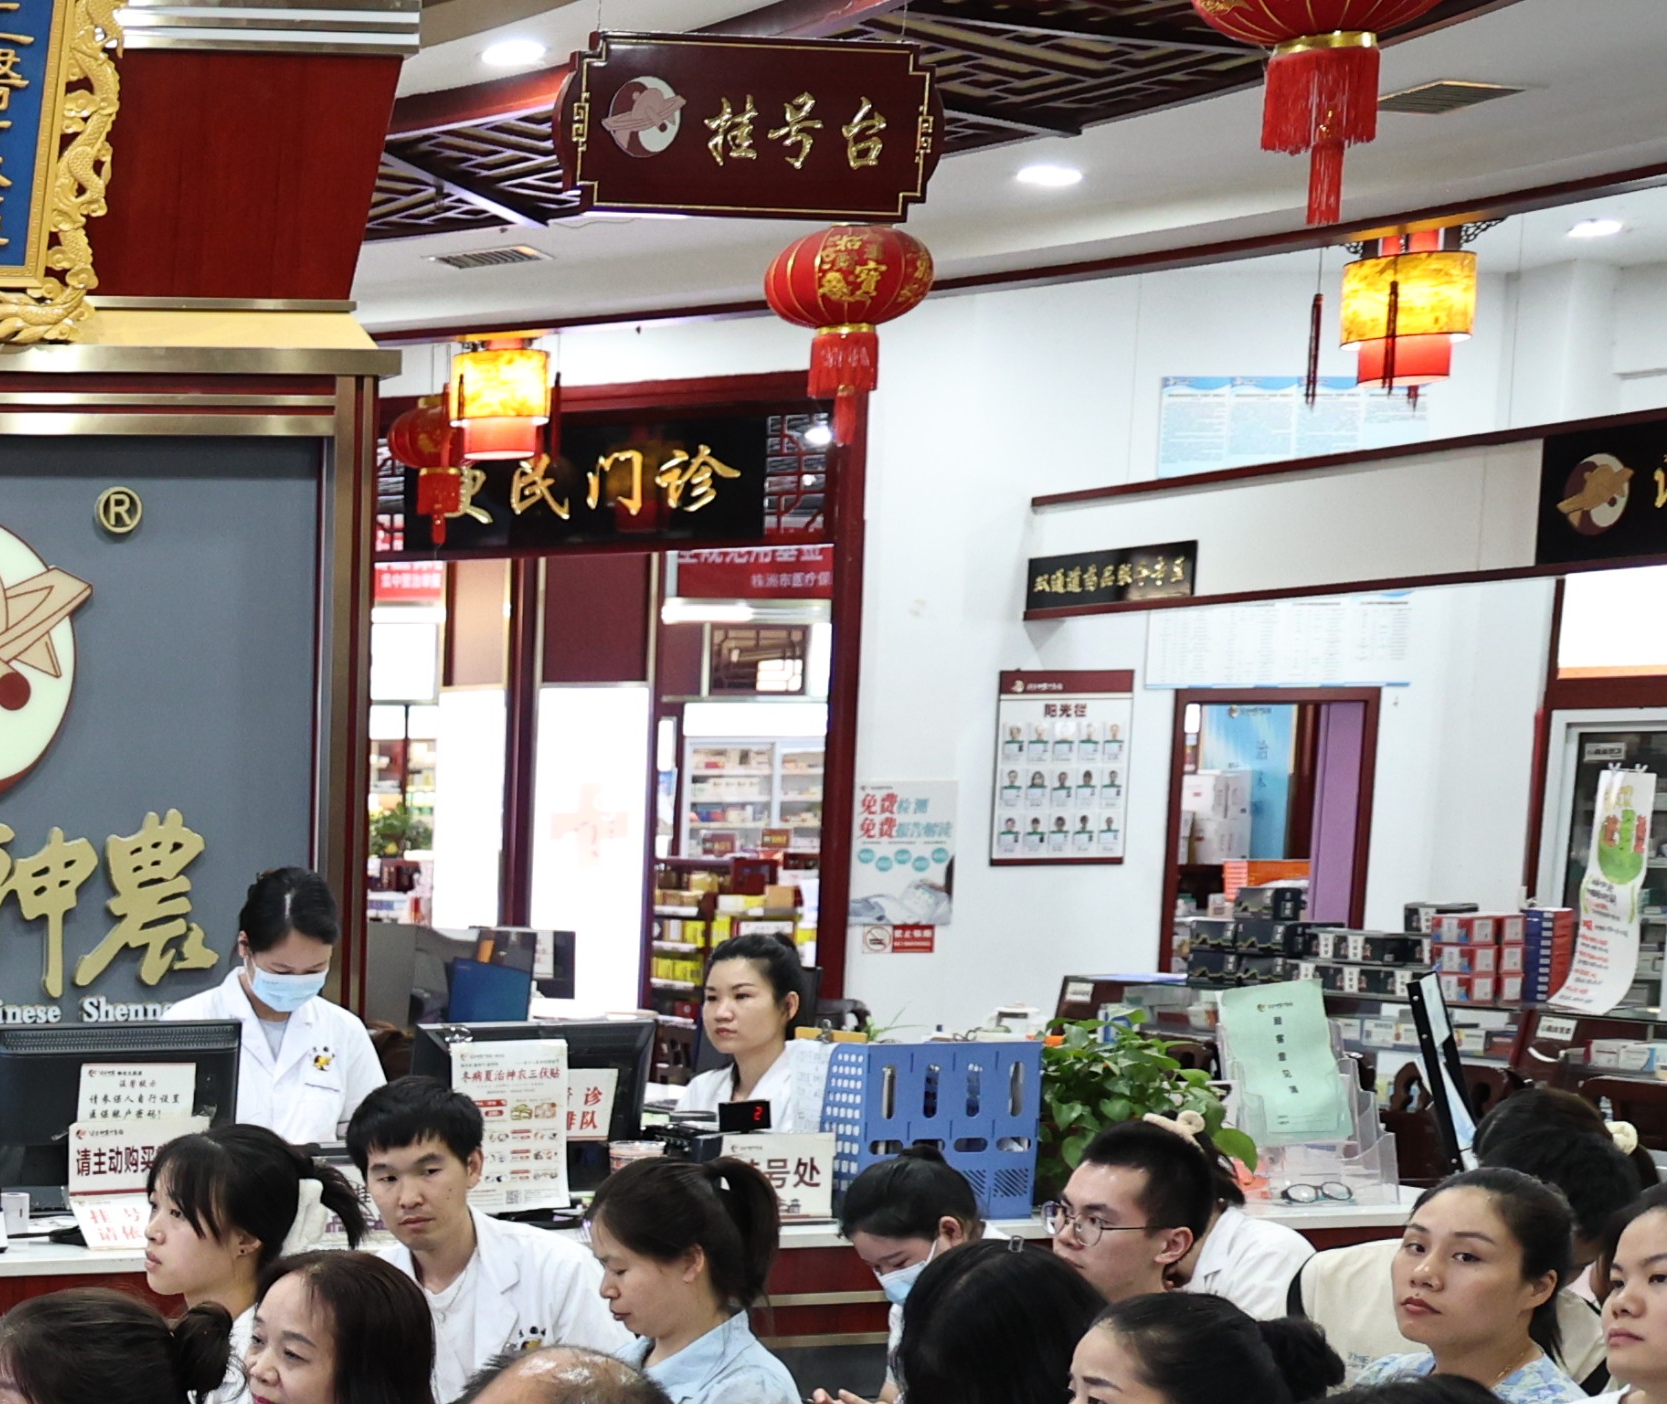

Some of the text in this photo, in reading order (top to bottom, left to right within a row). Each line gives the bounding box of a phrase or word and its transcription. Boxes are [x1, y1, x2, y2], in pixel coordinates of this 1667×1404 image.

[703, 91, 888, 170] 挂号台
[752, 1105, 764, 1121] 2
[76, 1145, 163, 1176] 请主动购买
[747, 1157, 822, 1189] 号处
